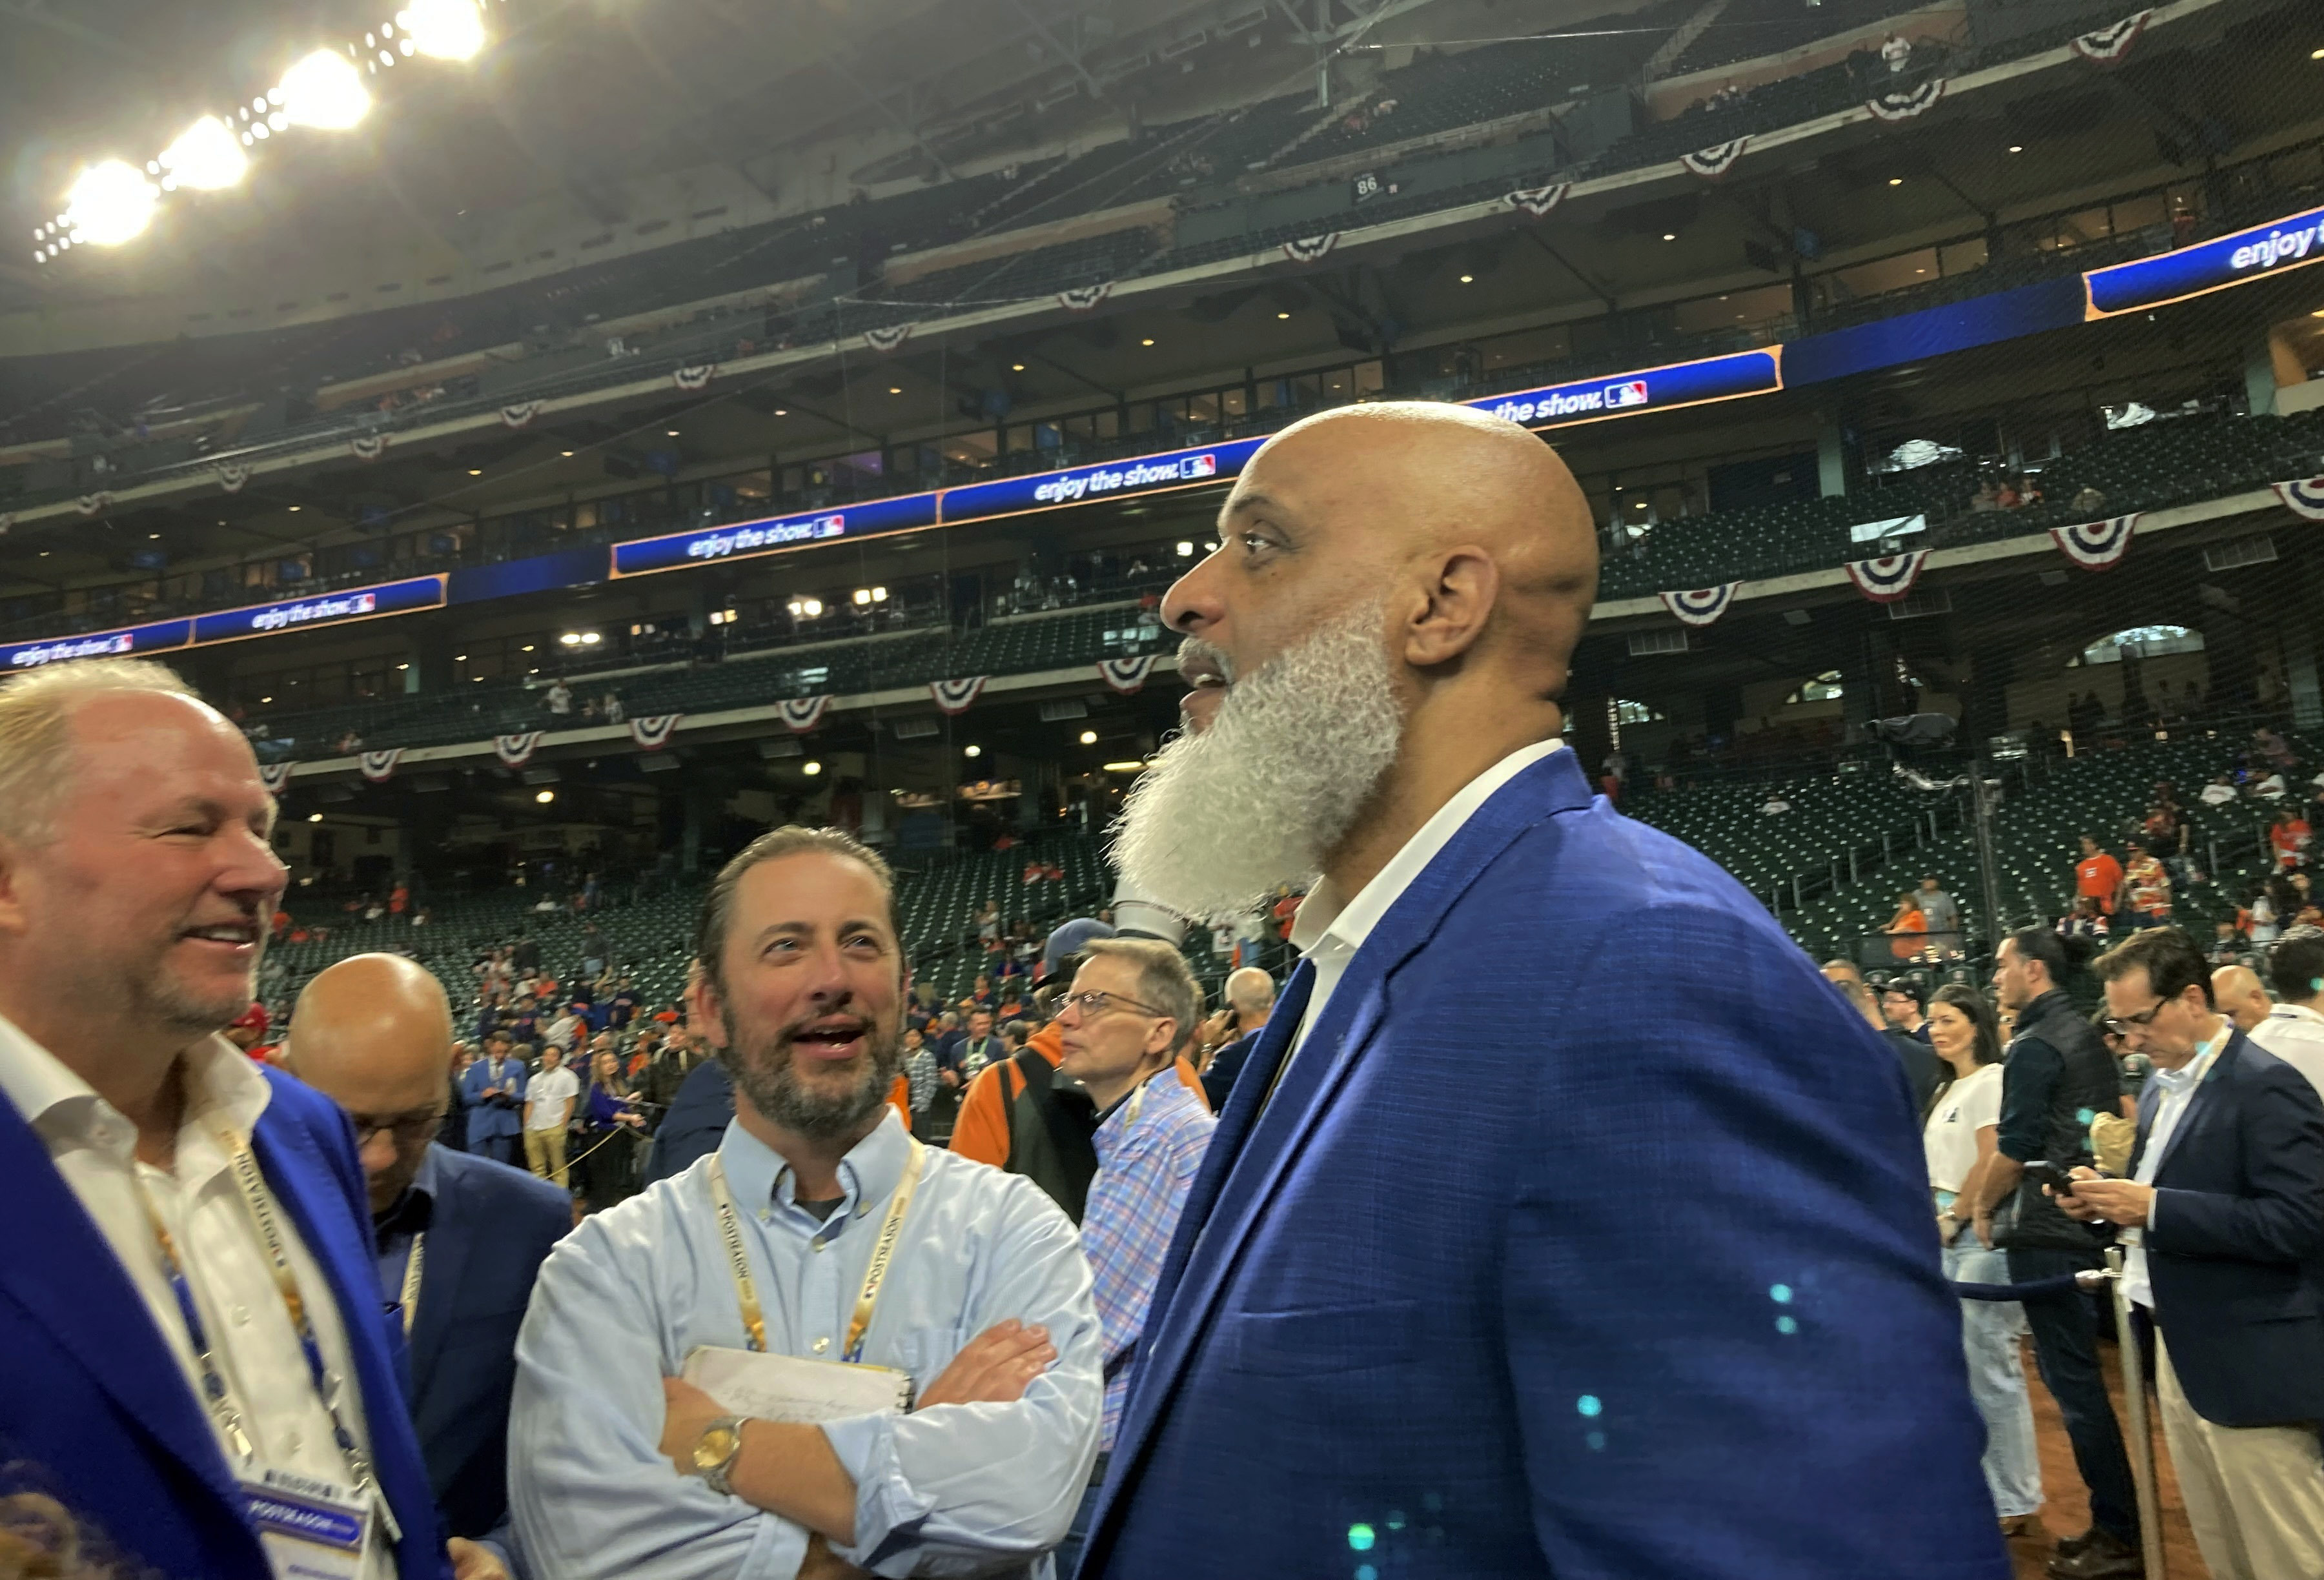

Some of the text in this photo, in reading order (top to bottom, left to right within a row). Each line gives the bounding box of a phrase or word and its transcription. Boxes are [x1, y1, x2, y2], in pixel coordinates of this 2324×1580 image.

[1358, 177, 1378, 195] 86
[2231, 230, 2316, 268] enjoy
[1034, 476, 1088, 503] enjoy
[1089, 471, 1123, 492] the
[688, 533, 735, 558] enjoy
[734, 529, 765, 549] the
[722, 1214, 749, 1279] POSTSEASON
[867, 1217, 901, 1284] POSTSEASON
